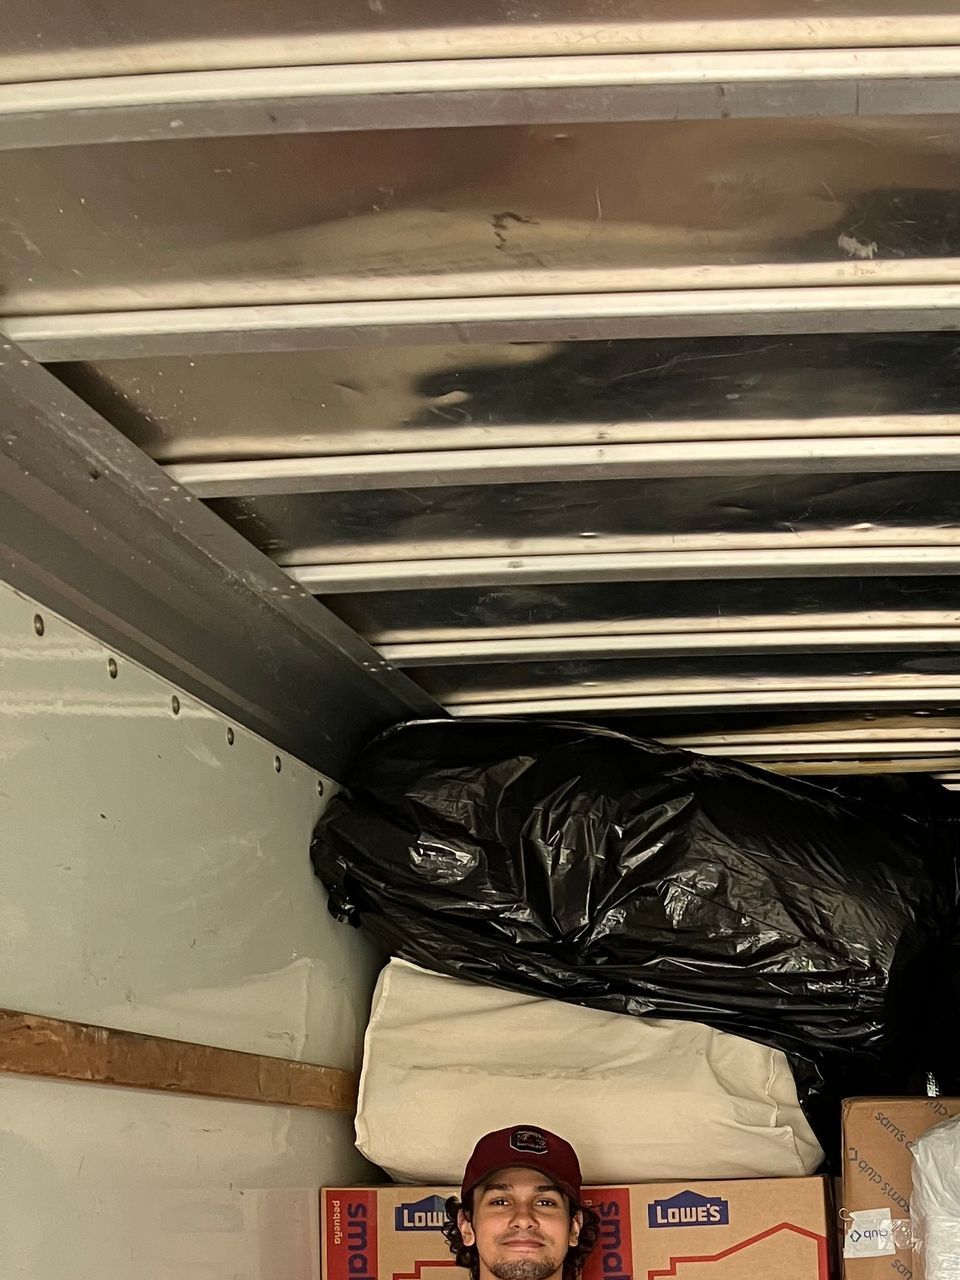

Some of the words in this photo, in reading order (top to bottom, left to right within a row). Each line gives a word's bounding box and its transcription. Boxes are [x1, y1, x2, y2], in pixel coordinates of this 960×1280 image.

[875, 1111, 907, 1143] sam's
[858, 1160, 883, 1184] club
[332, 1200, 343, 1245] pequeña
[656, 1203, 721, 1224] LOWE'S
